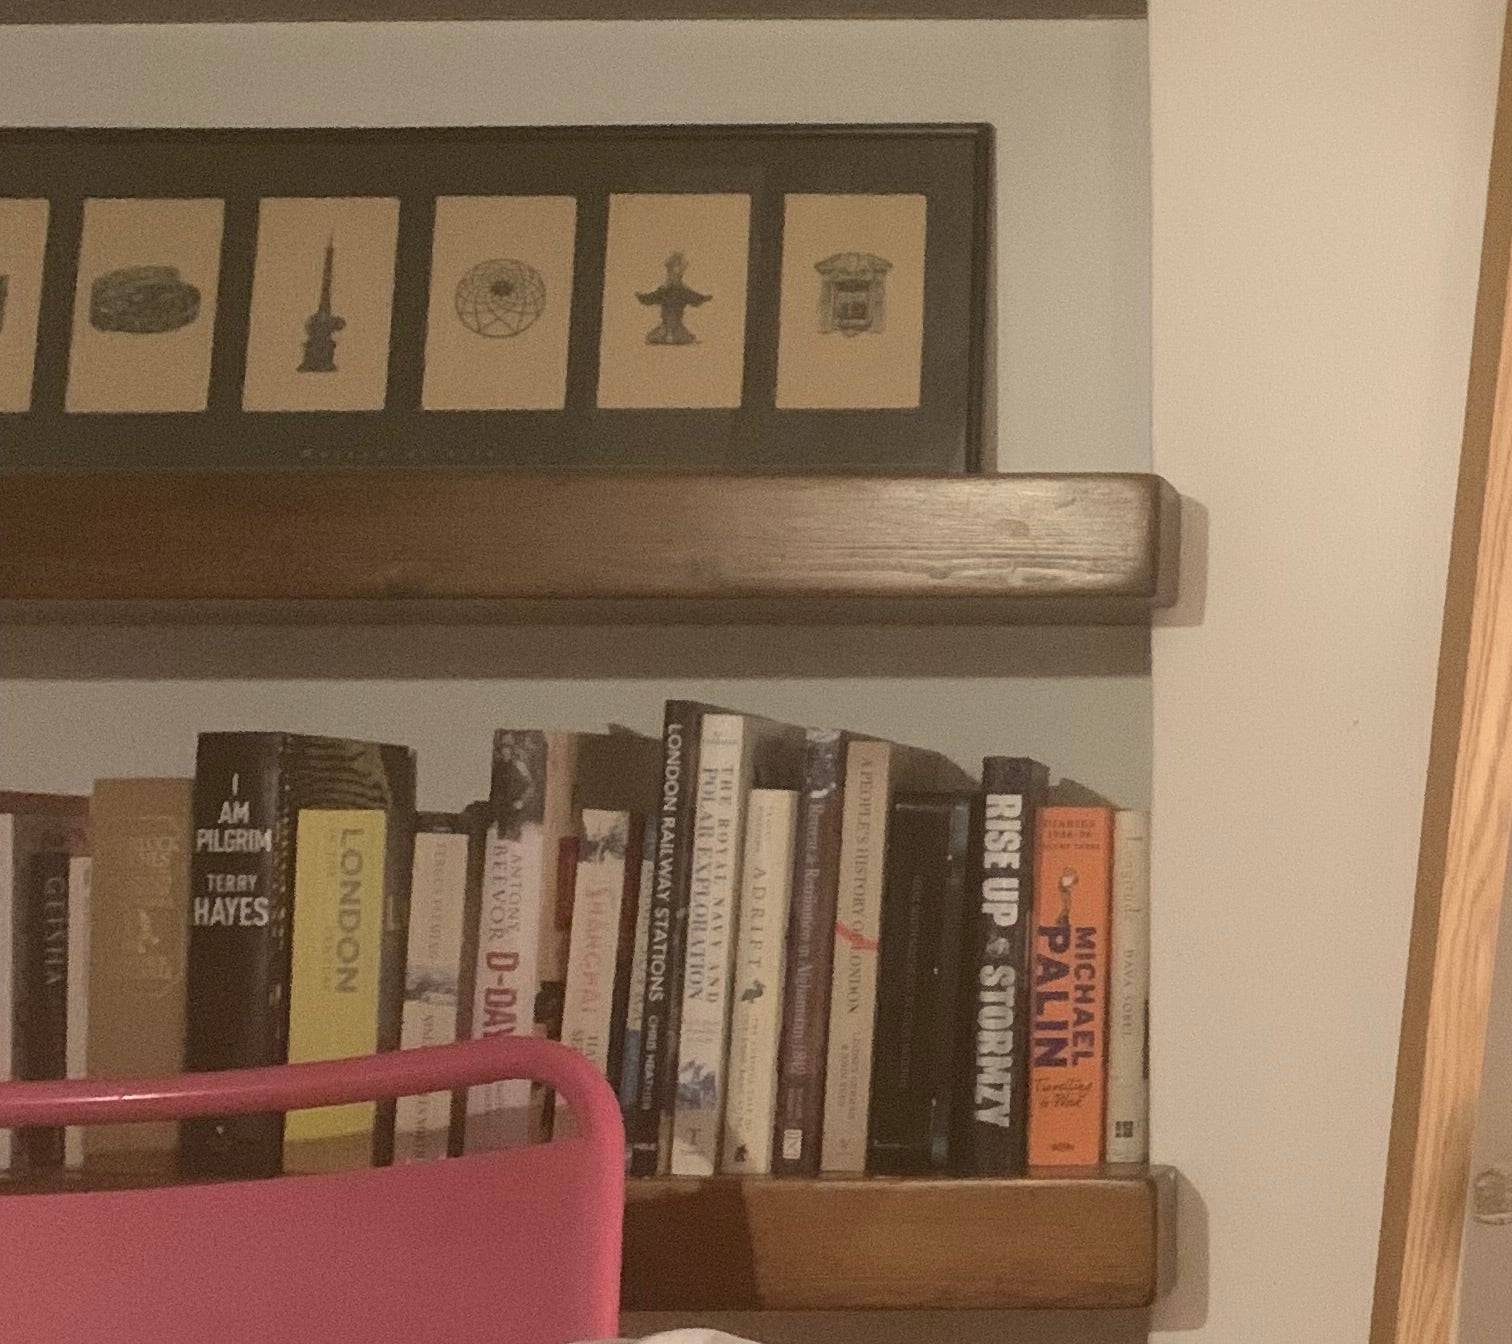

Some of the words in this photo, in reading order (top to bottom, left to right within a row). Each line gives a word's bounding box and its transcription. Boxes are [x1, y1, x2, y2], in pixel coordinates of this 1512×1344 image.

[231, 772, 239, 795] I
[662, 724, 683, 811] LONDON
[718, 764, 734, 805] THE
[217, 801, 250, 824] AM
[697, 768, 719, 838] POLAR
[983, 793, 1024, 871] RISE
[196, 828, 272, 853] PILGRIM
[656, 817, 677, 902] RAILWAY
[713, 818, 731, 884] ROYAL
[193, 896, 270, 927] HAYES
[207, 873, 258, 892] TERRY
[335, 828, 365, 993] LONDON
[487, 844, 510, 942] BEEVOR
[506, 854, 523, 933] ANTONY
[747, 867, 768, 968] ADRIFT
[851, 848, 870, 917] HISTORY
[980, 877, 1020, 928] UP
[649, 907, 671, 1001] STATIONS
[687, 846, 714, 1000] EXPLORATION
[710, 897, 727, 948] NAVY
[706, 962, 720, 1003] AND
[1032, 924, 1072, 1067] PALIN
[1071, 926, 1097, 1067] MICHAEL
[1122, 950, 1135, 987] DAVA
[973, 966, 1016, 1128] STORMZY
